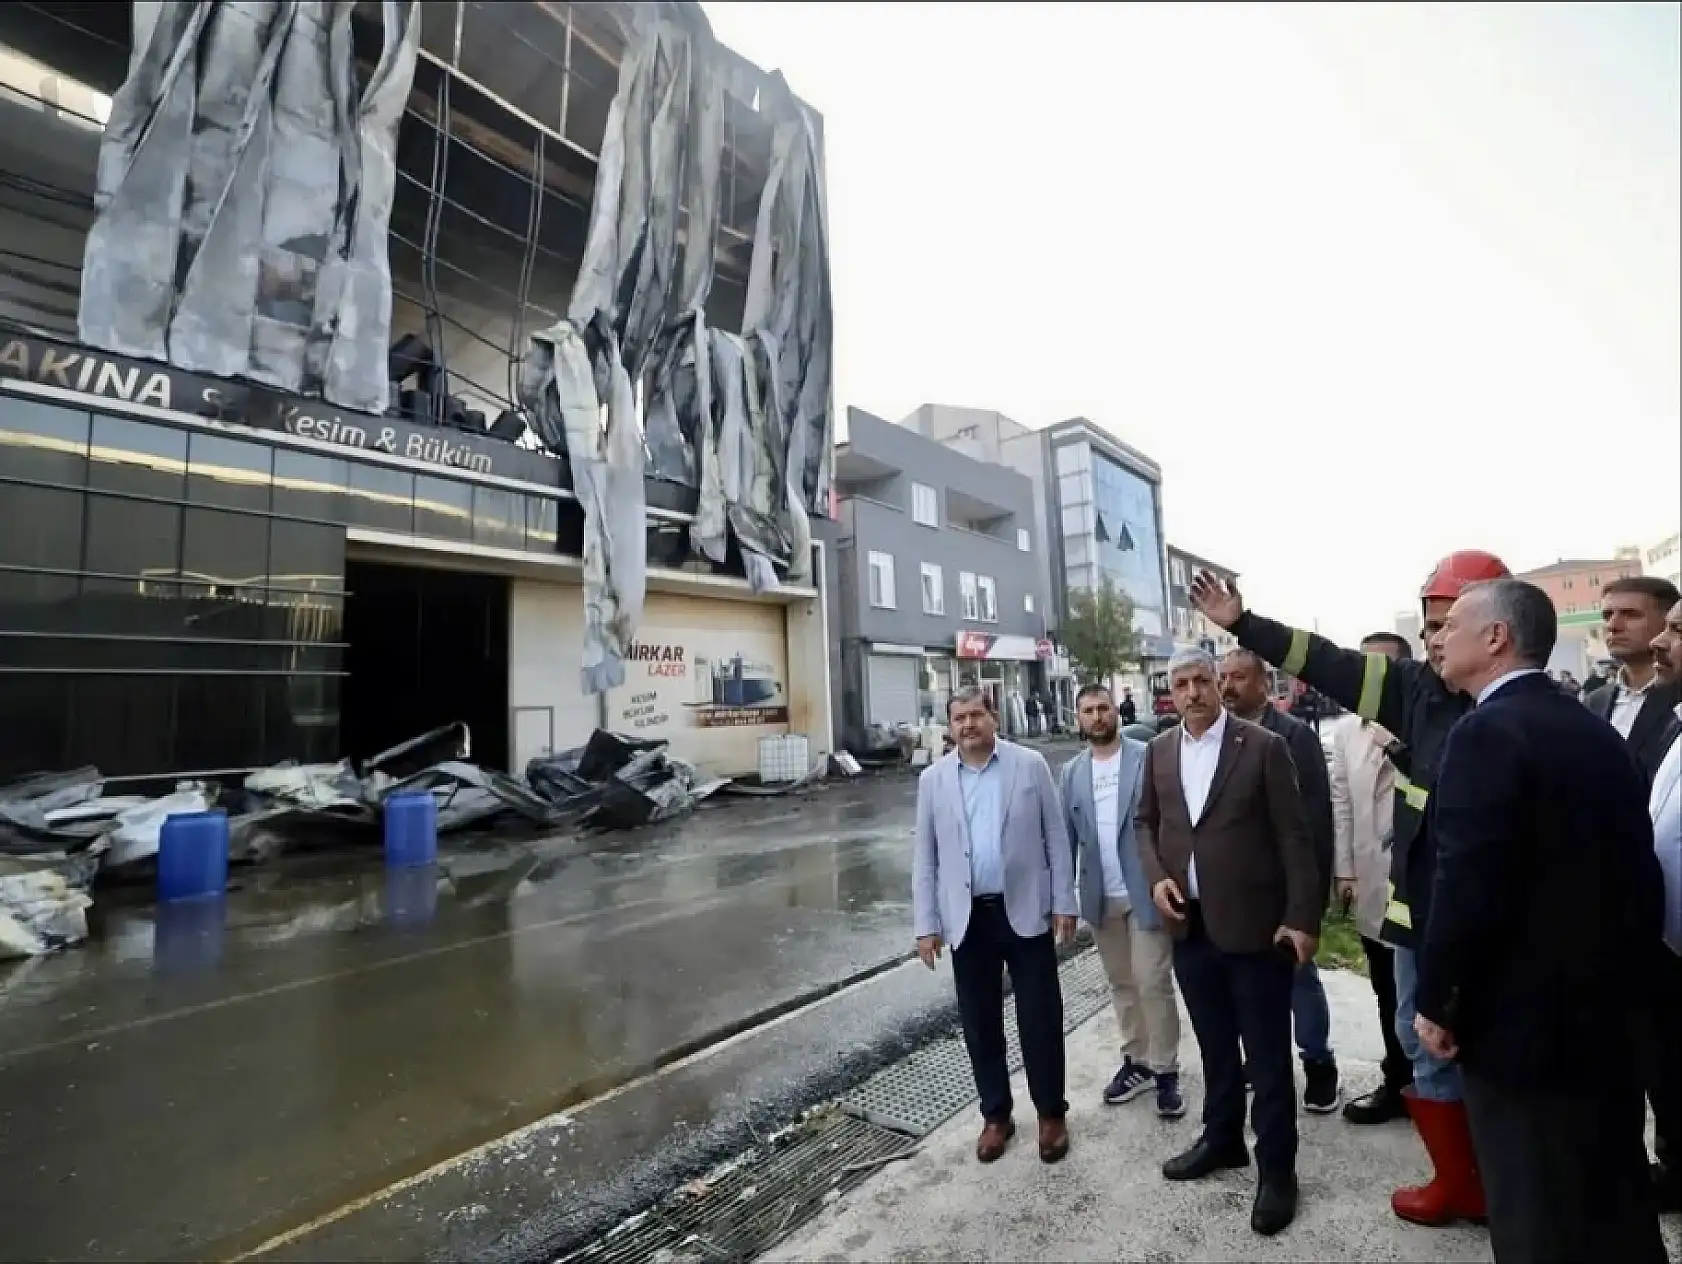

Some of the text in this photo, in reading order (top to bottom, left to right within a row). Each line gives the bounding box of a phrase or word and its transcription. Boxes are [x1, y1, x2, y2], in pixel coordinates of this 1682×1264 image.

[374, 427, 396, 452] &
[406, 433, 492, 473] Büküm
[648, 663, 686, 676] LAZER
